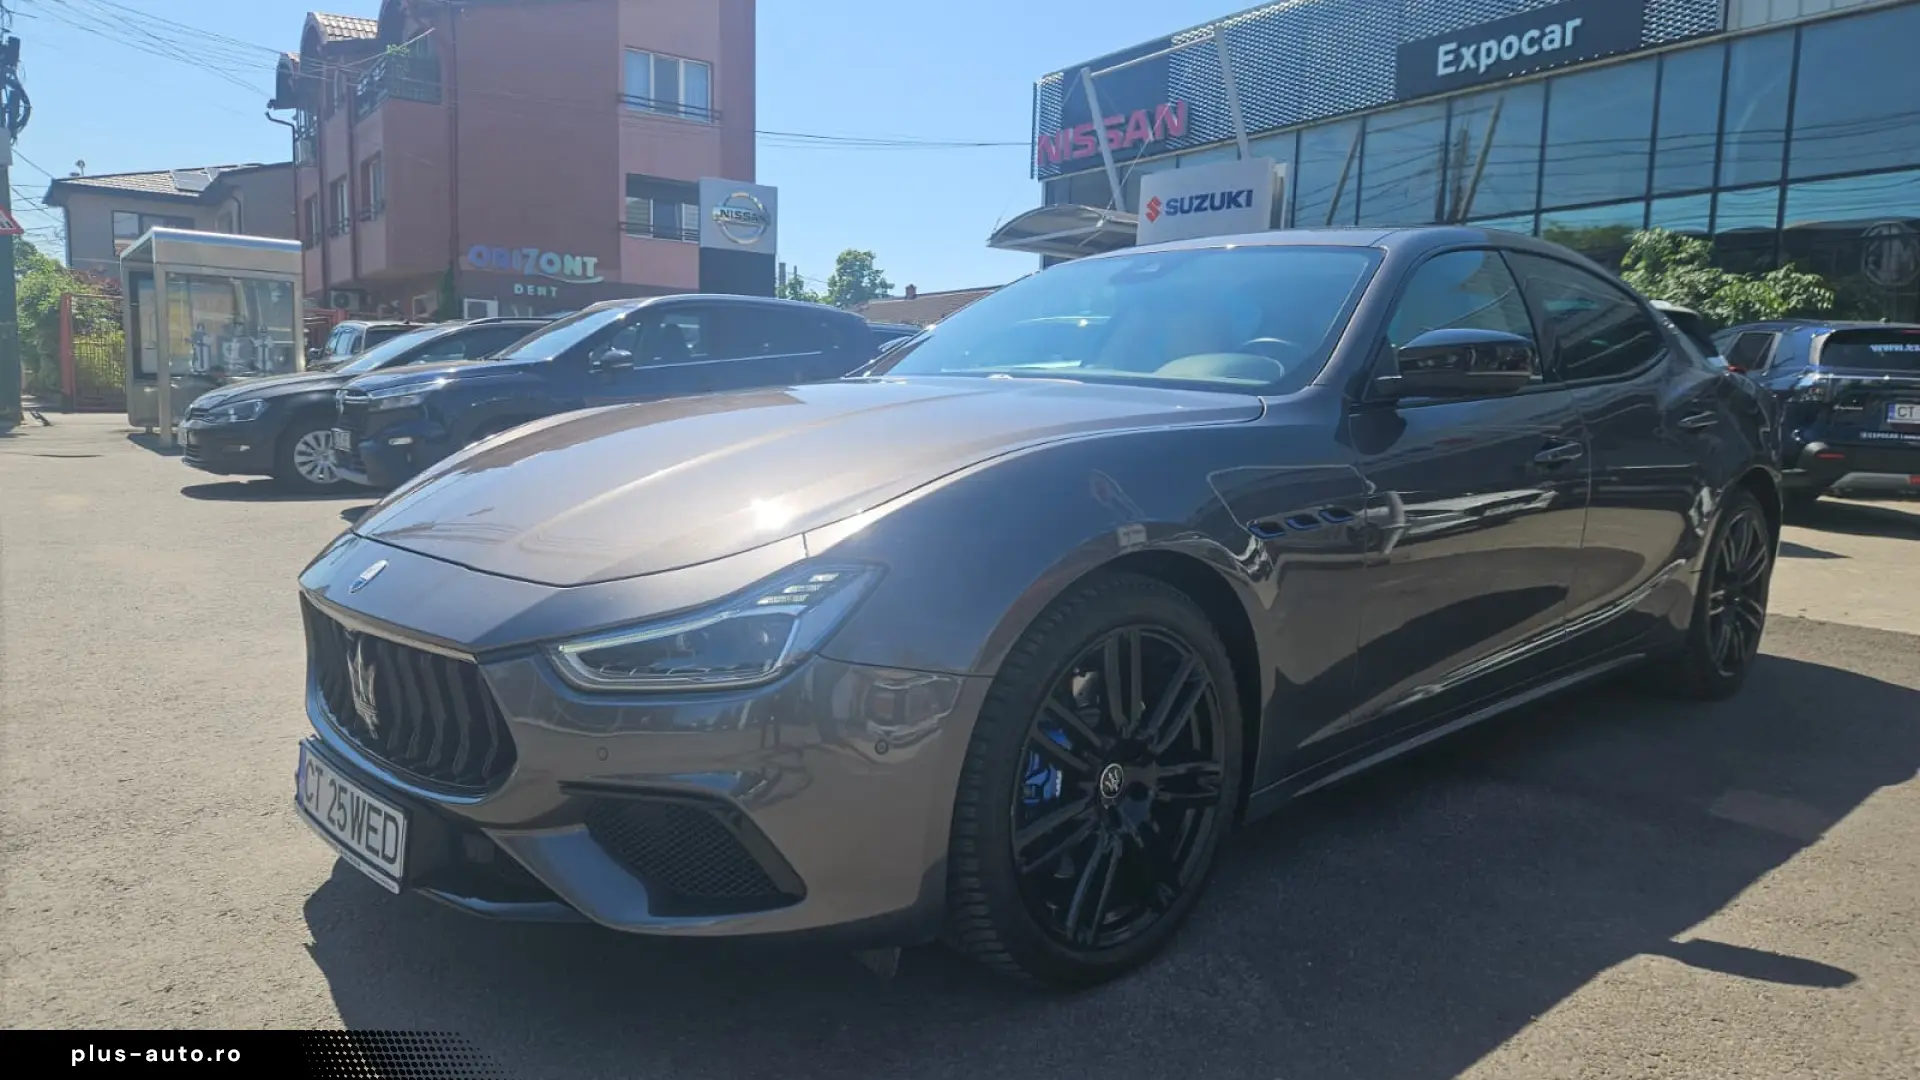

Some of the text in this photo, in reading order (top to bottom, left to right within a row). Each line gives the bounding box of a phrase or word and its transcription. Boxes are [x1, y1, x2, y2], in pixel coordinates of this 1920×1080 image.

[1436, 17, 1583, 77] Expocar
[1037, 98, 1186, 168] NISSAN
[1165, 189, 1253, 217] SUZUKI
[513, 283, 558, 297] DENT
[305, 758, 324, 813] CT
